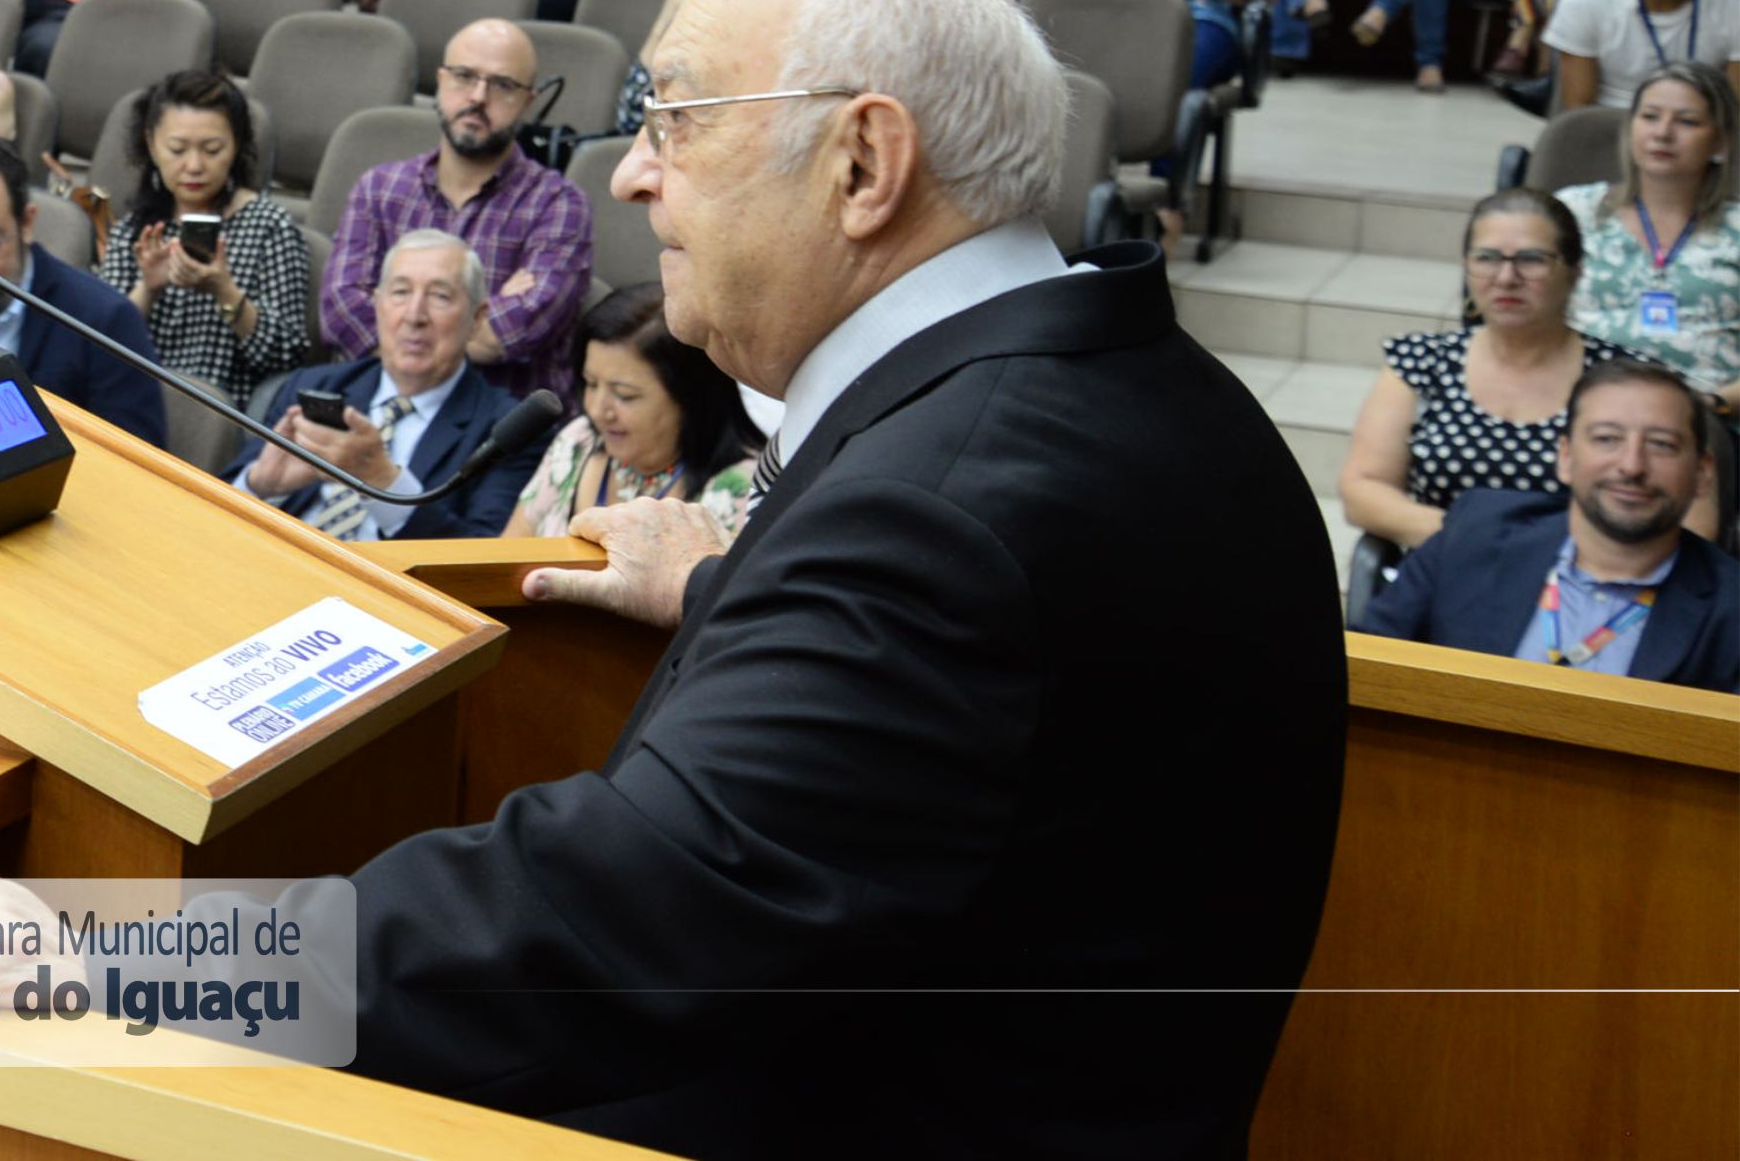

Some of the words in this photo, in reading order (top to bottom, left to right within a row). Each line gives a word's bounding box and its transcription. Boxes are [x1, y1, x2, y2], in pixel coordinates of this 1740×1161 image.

[190, 666, 276, 711] Estamos
[264, 656, 297, 676] ao
[281, 629, 343, 662] VIVO
[222, 641, 271, 669] ATENÇÃO
[326, 652, 394, 687] facebook
[249, 714, 296, 742] ONLINE
